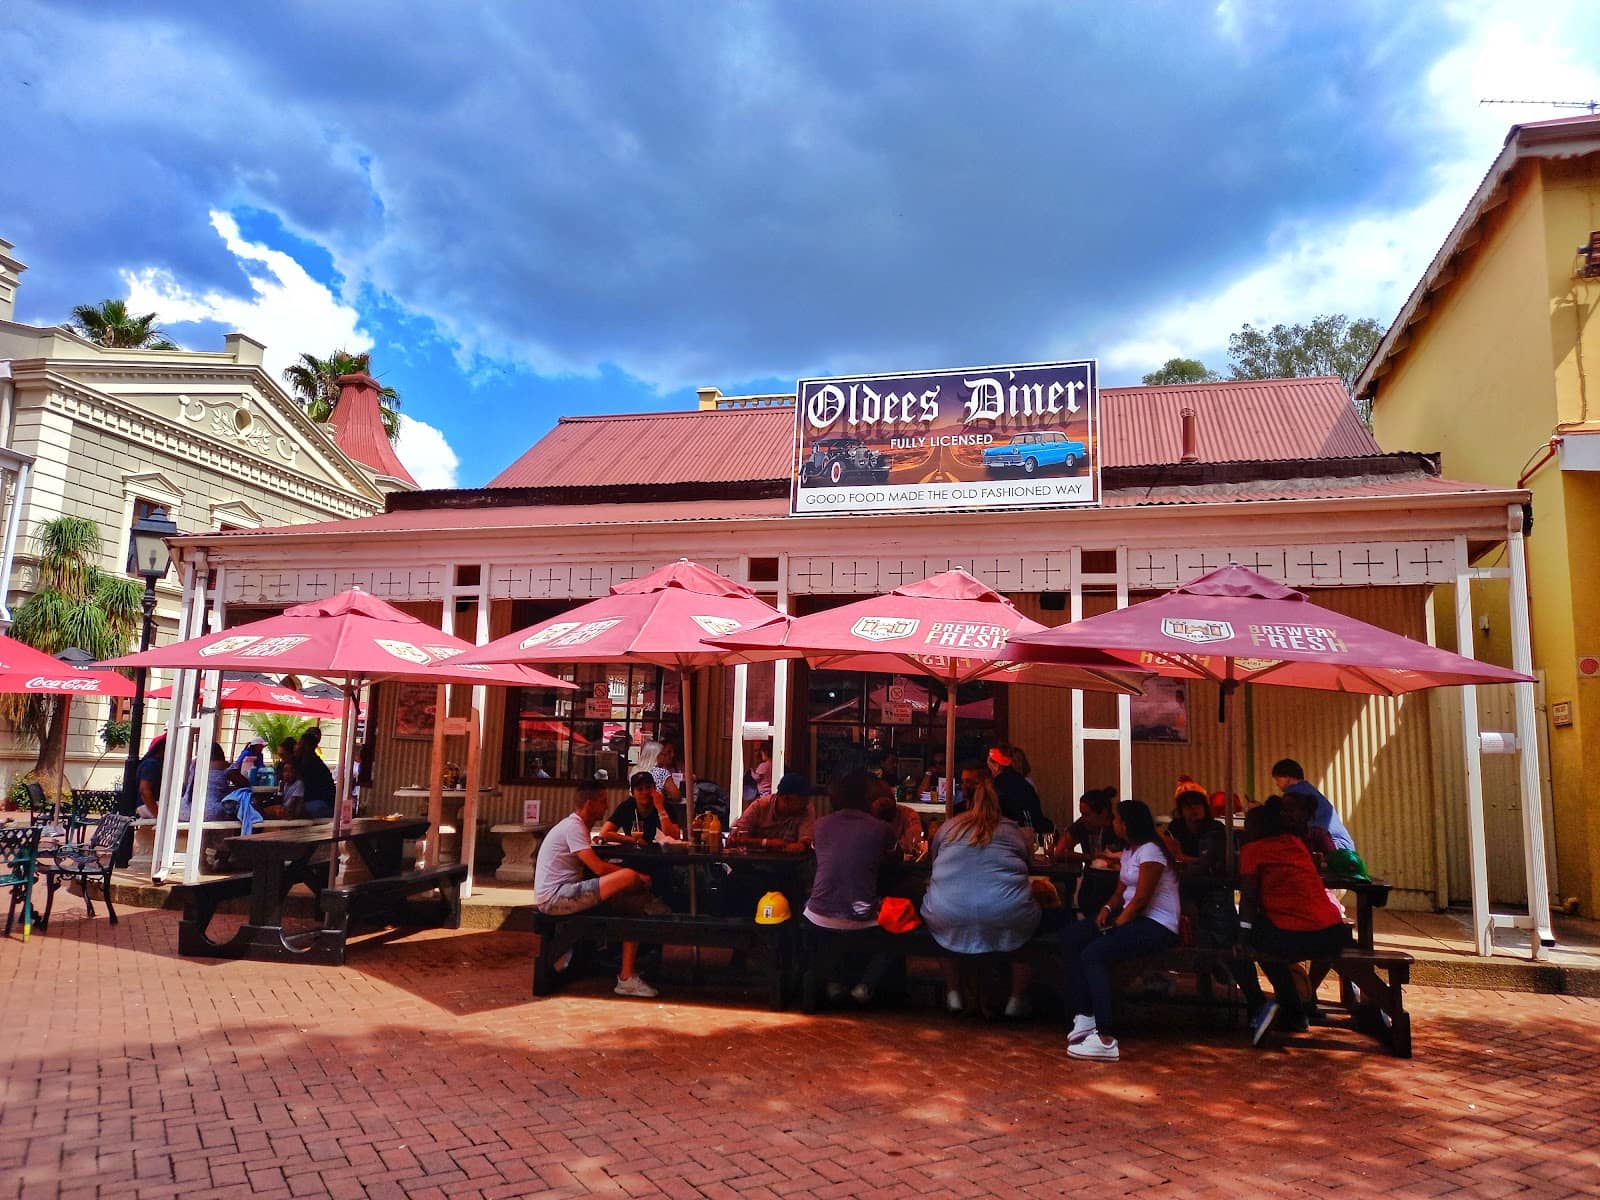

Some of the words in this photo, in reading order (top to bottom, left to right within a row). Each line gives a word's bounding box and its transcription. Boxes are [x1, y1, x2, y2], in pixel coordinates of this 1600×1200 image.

[807, 383, 940, 428] Oldees
[963, 370, 1085, 425] Diner
[890, 437, 926, 449] FULLY
[930, 433, 994, 447] LICENSED
[806, 493, 846, 505] GOOD
[849, 492, 885, 503] FOOD
[888, 490, 925, 502] MADE
[927, 489, 949, 500] THE
[951, 488, 978, 500] OLD
[981, 486, 1051, 499] FASHIONED
[1055, 484, 1082, 495] WAY
[931, 622, 1011, 637] BREWERY
[1248, 624, 1337, 639] BREWERY
[924, 630, 1010, 649] FRESH
[1250, 633, 1349, 653] FRESH
[25, 676, 102, 691] Coca-Cola
